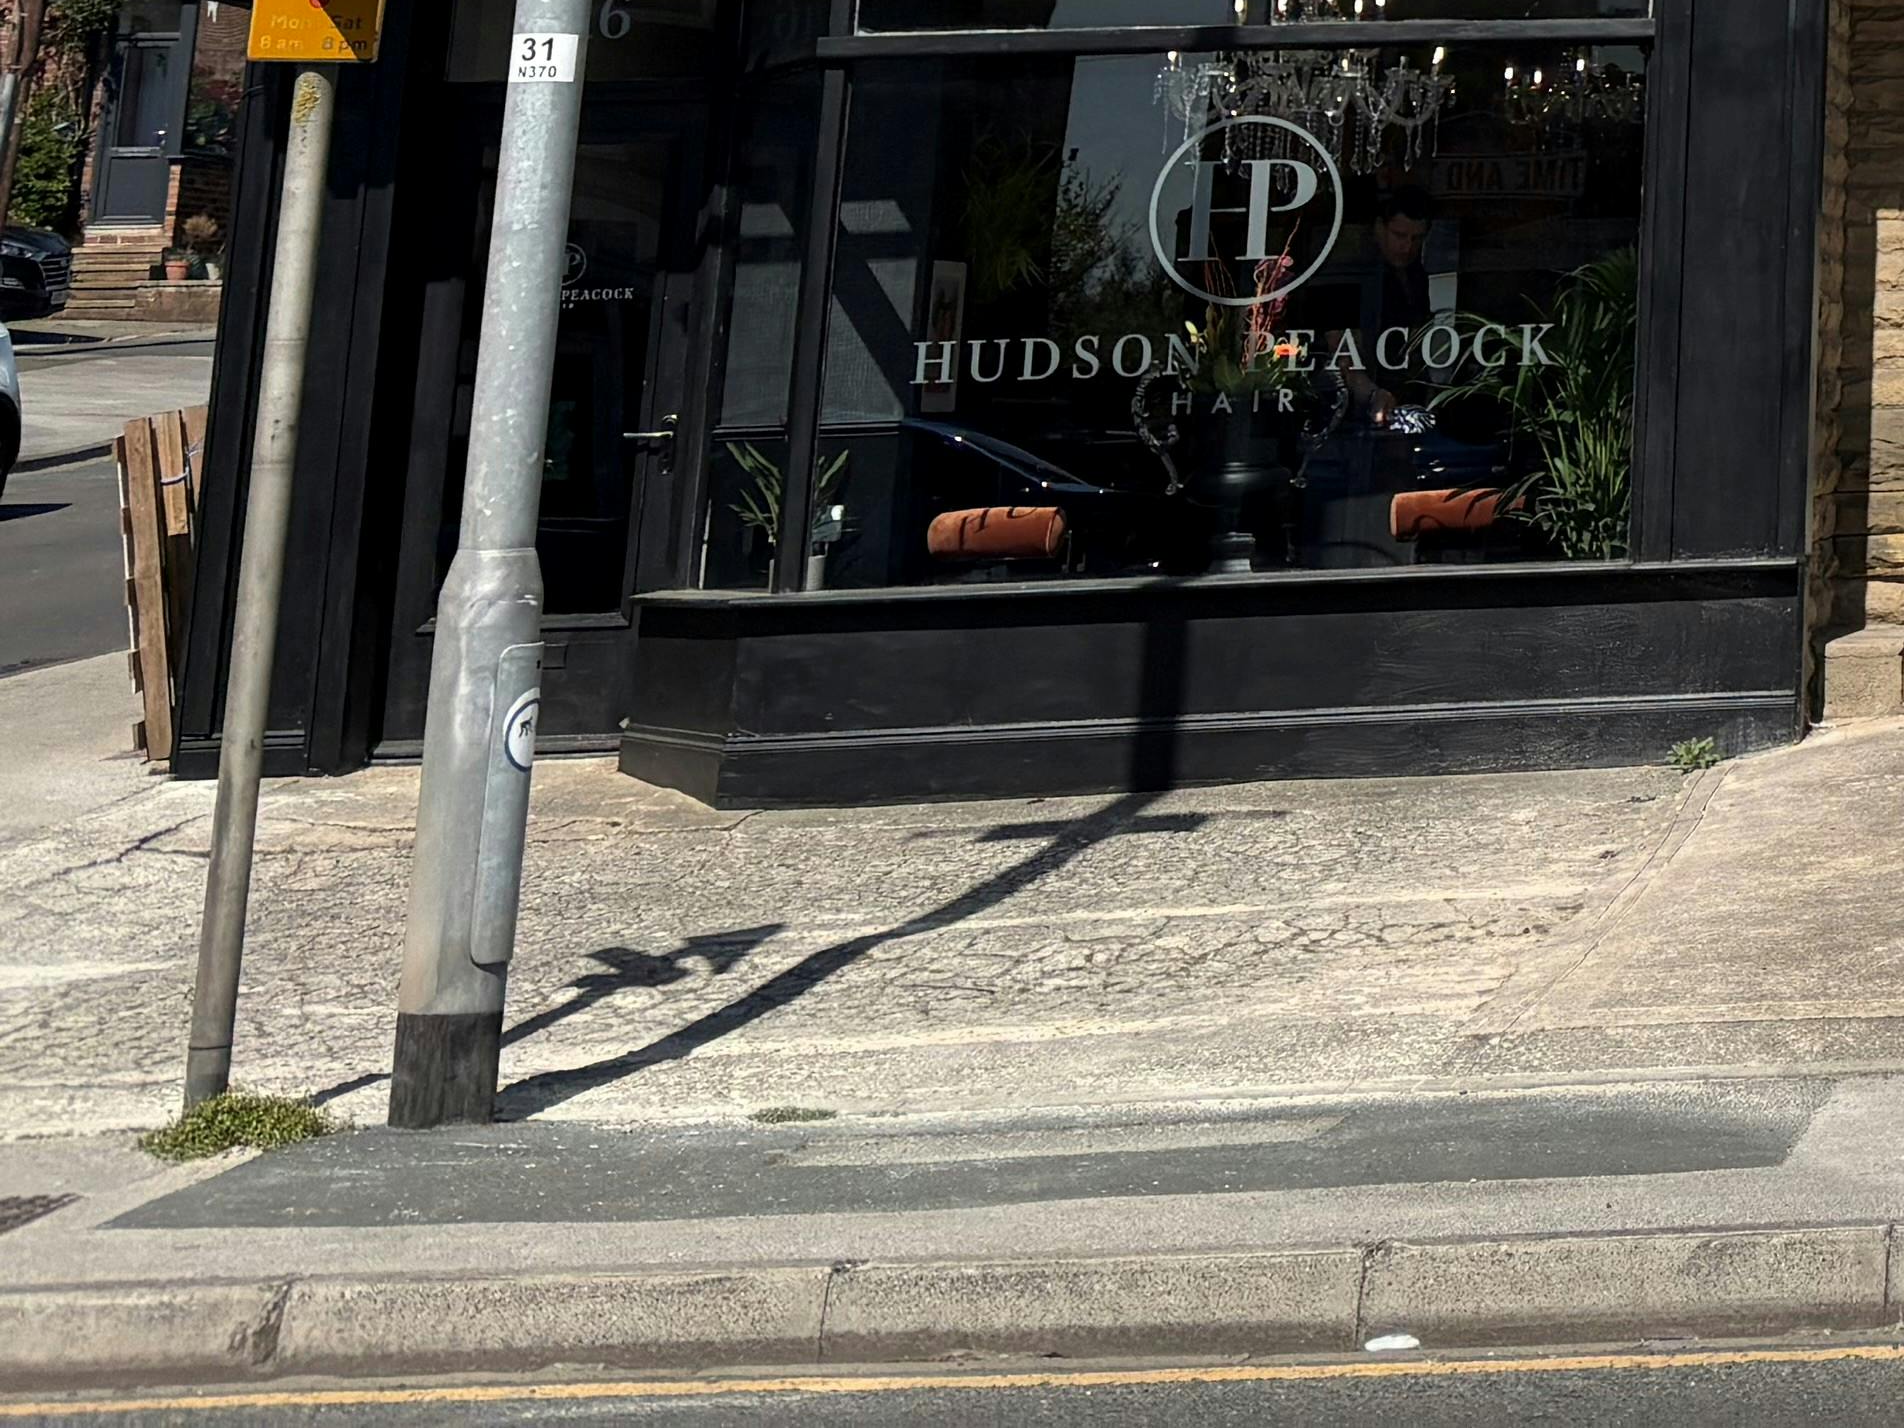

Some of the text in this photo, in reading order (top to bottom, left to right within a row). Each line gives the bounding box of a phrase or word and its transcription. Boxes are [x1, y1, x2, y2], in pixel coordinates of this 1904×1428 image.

[521, 38, 555, 62] 31
[517, 66, 557, 79] N370
[1177, 158, 1318, 262] HP
[562, 287, 634, 301] PEACOCK
[909, 322, 1557, 384] HUDSON PEACOCK
[1170, 388, 1295, 416] HAIR
